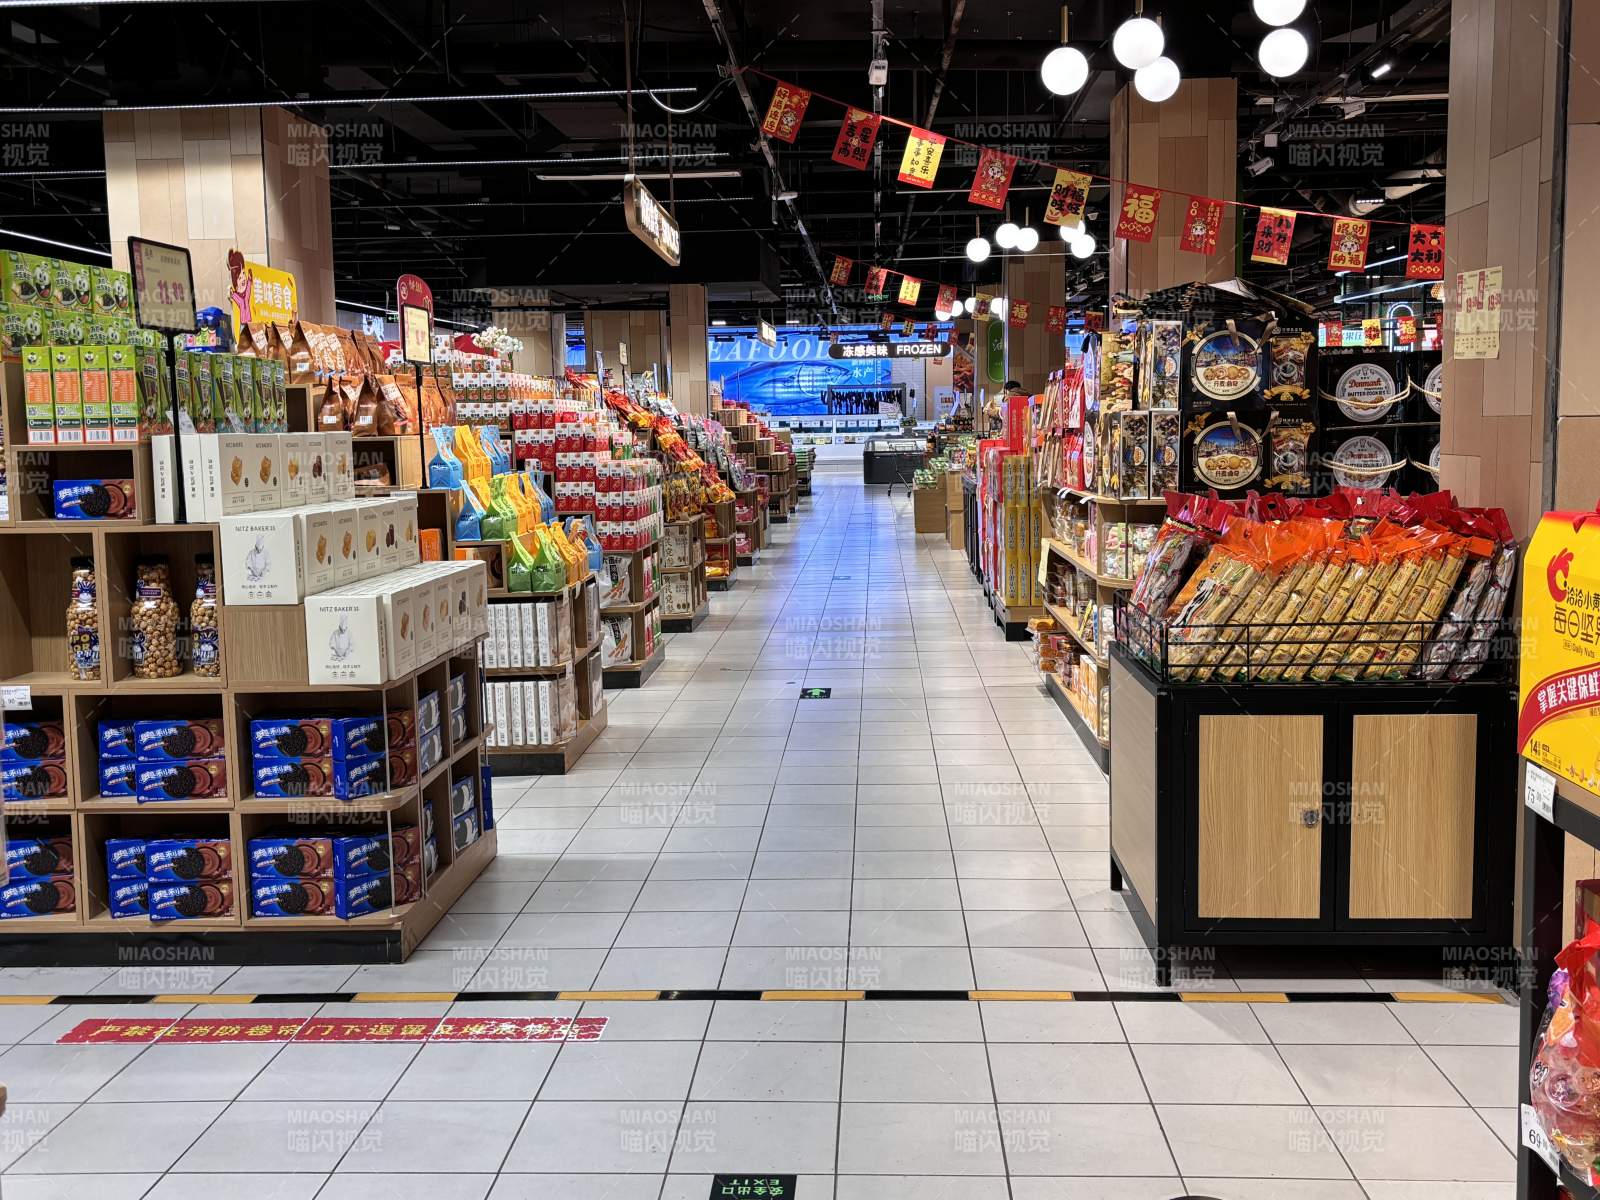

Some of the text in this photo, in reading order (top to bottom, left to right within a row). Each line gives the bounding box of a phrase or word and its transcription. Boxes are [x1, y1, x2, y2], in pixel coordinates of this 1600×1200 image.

[1124, 195, 1154, 223] 福
[1338, 223, 1366, 236] 招财
[1332, 253, 1360, 266] 纳福
[1411, 249, 1442, 263] 大利
[253, 277, 292, 311] 美味零食
[1012, 303, 1028, 319] 福
[842, 345, 888, 357] 冻感美味
[896, 344, 941, 355] FROZEN
[1348, 378, 1383, 388] Denmark
[722, 1186, 784, 1196] 安全出口
